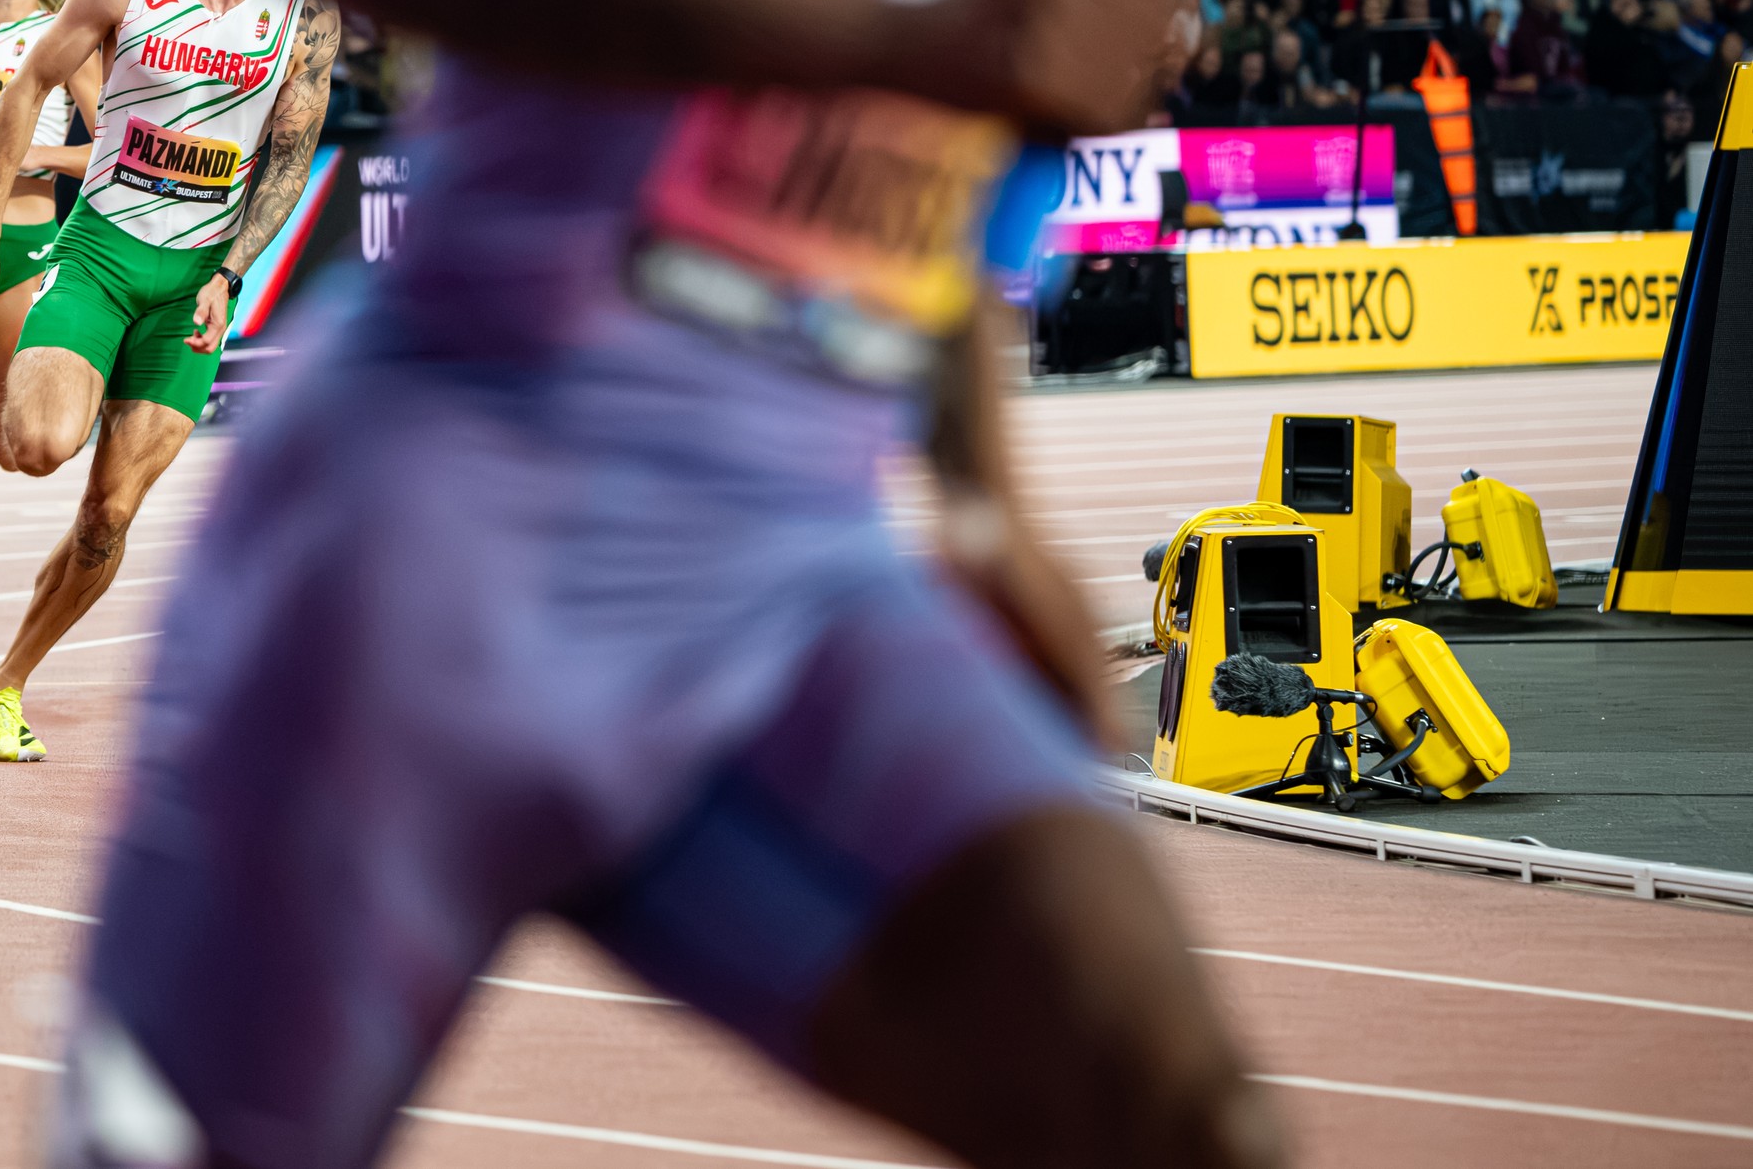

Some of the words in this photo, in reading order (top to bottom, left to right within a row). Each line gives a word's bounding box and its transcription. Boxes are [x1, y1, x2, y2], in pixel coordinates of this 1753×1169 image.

[140, 34, 261, 91] HUNGARY
[126, 127, 237, 178] PÁZMÁNDI
[358, 156, 409, 186] WORLD
[1071, 148, 1143, 207] NY
[120, 171, 153, 189] ULTIMATE
[360, 192, 408, 263] ULT
[1250, 267, 1414, 347] SEIKO
[1579, 275, 1680, 326] PROSP
